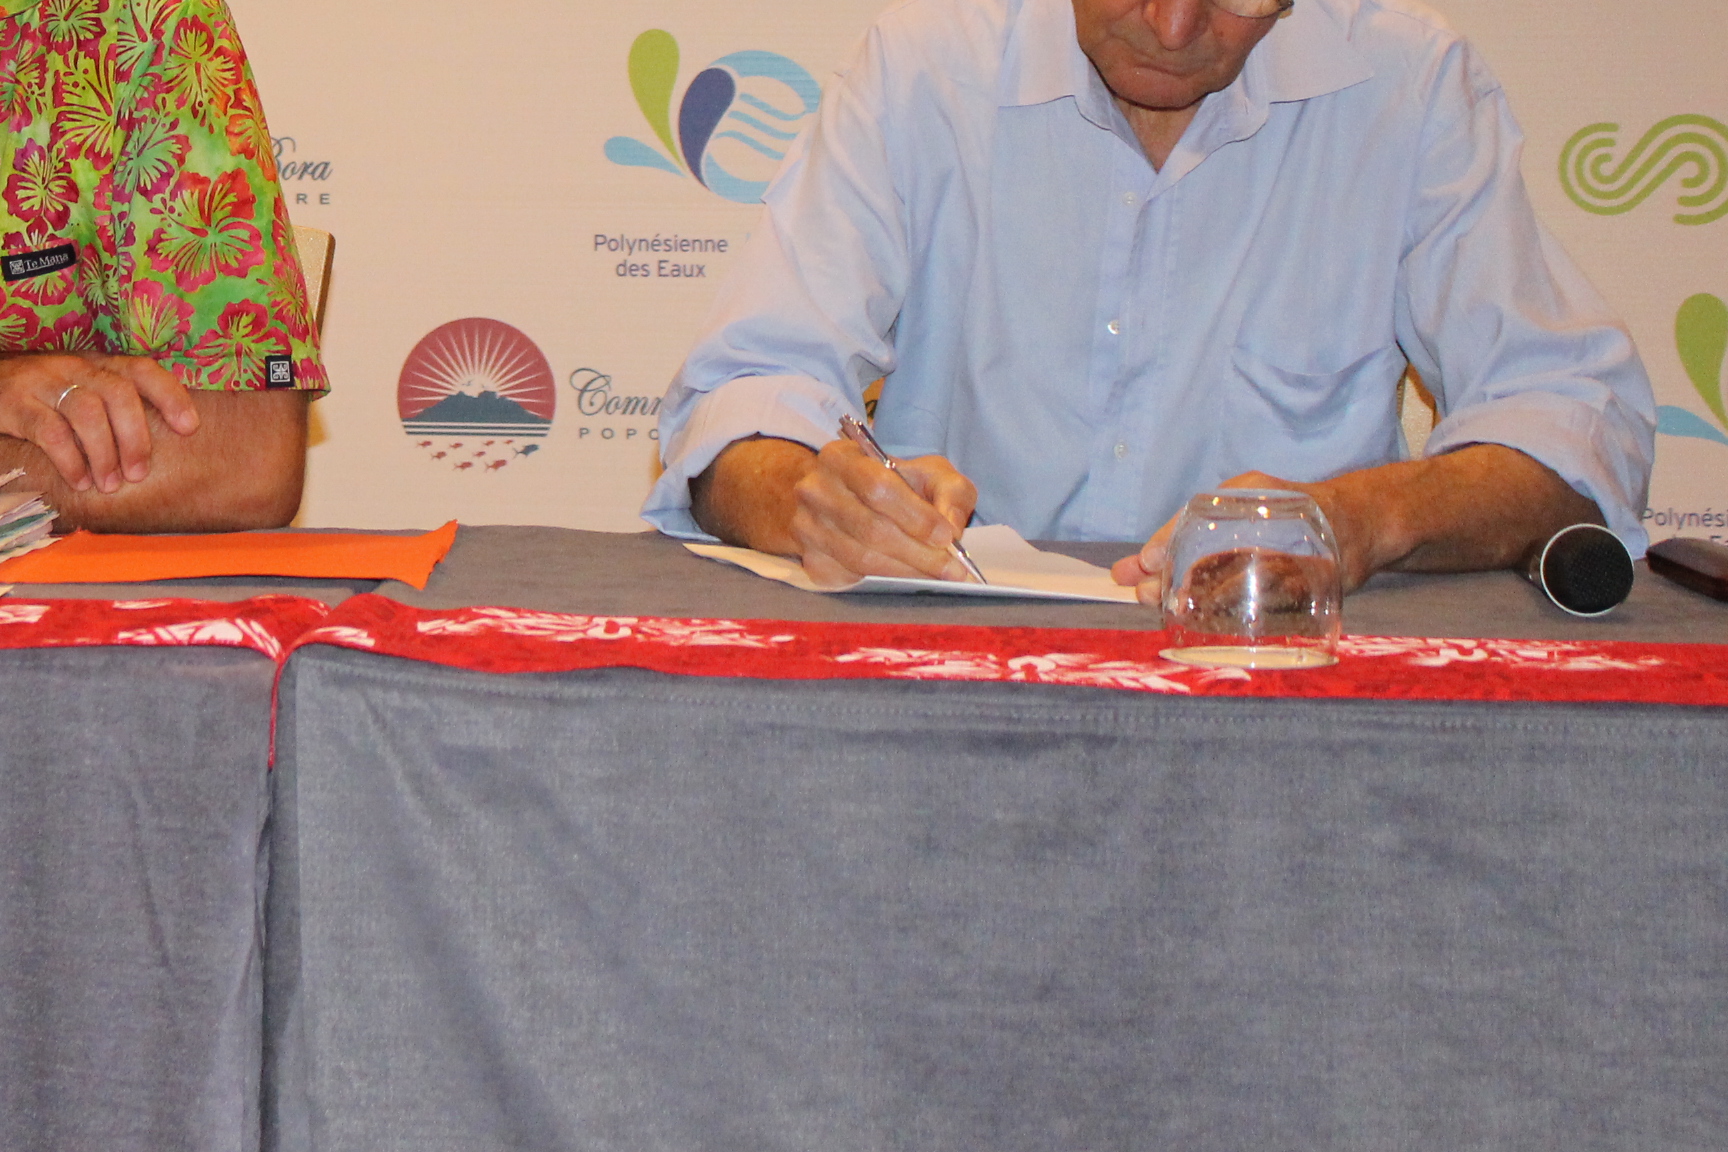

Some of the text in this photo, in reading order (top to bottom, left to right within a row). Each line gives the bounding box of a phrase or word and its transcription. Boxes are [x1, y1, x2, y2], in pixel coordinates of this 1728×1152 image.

[295, 192, 331, 206] RE
[593, 233, 729, 257] Polynésienne
[616, 259, 707, 278] des Eaux
